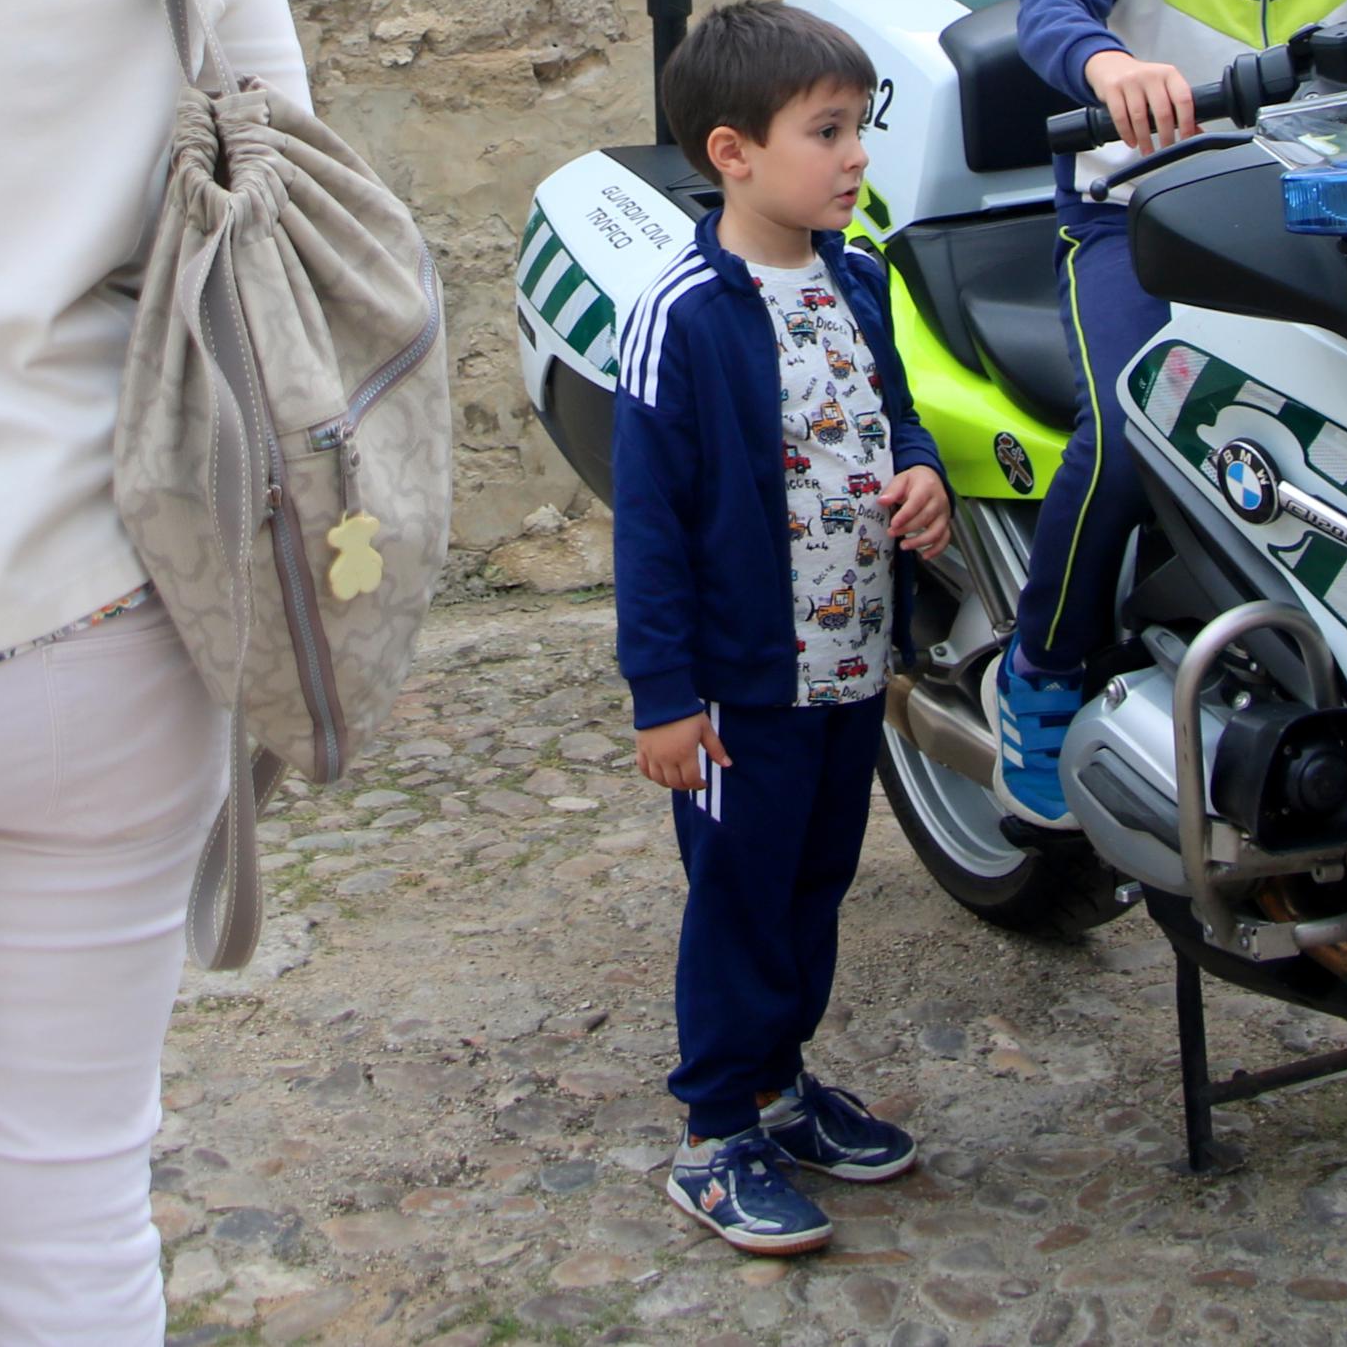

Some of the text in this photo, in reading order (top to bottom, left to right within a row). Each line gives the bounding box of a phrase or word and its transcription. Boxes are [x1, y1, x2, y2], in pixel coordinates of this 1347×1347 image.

[601, 185, 674, 251] GUARDIA CIVIL
[1223, 449, 1271, 486] BMW
